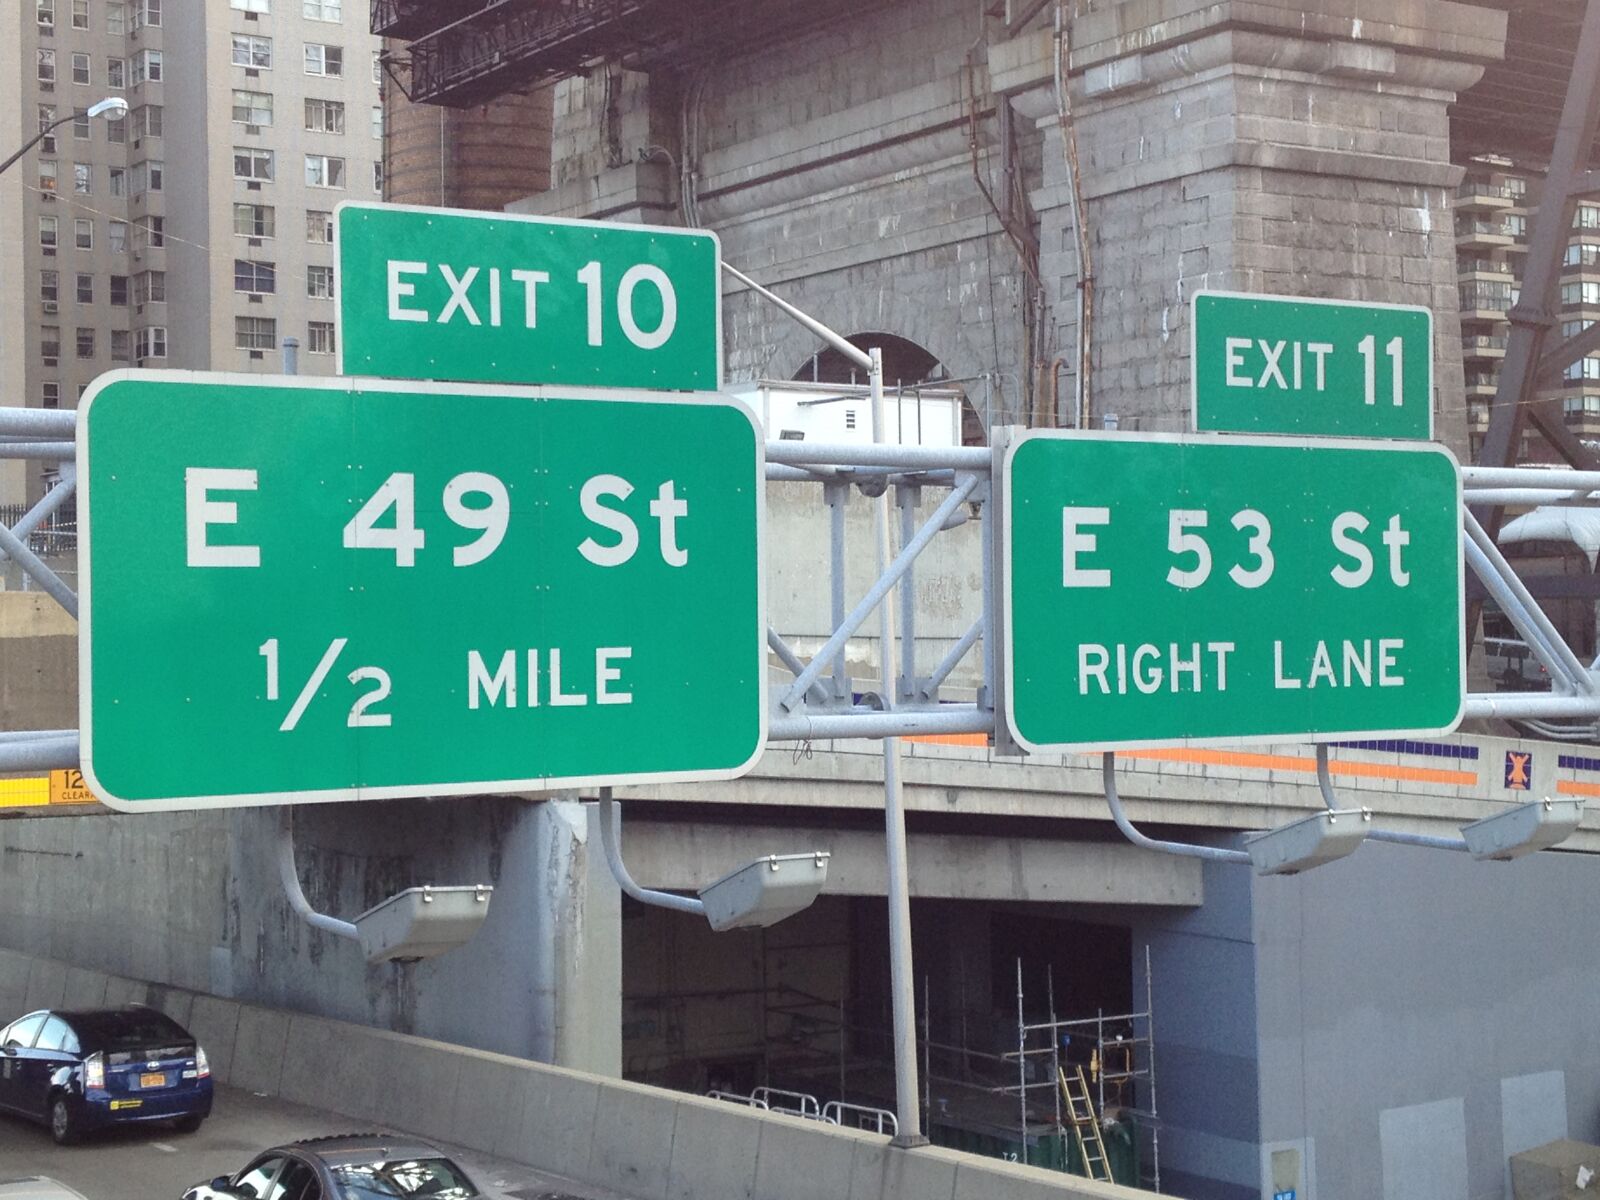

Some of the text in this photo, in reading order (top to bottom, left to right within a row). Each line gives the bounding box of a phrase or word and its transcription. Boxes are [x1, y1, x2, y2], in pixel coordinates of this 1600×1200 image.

[387, 259, 677, 350] EXIT 10
[1225, 334, 1403, 407] EXIT 11
[185, 467, 688, 568] E 49 St
[1062, 506, 1410, 589] E 53 St
[259, 638, 633, 731] 1/2 MILE
[1078, 638, 1404, 695] RIGHT LANE
[64, 770, 84, 789] 12
